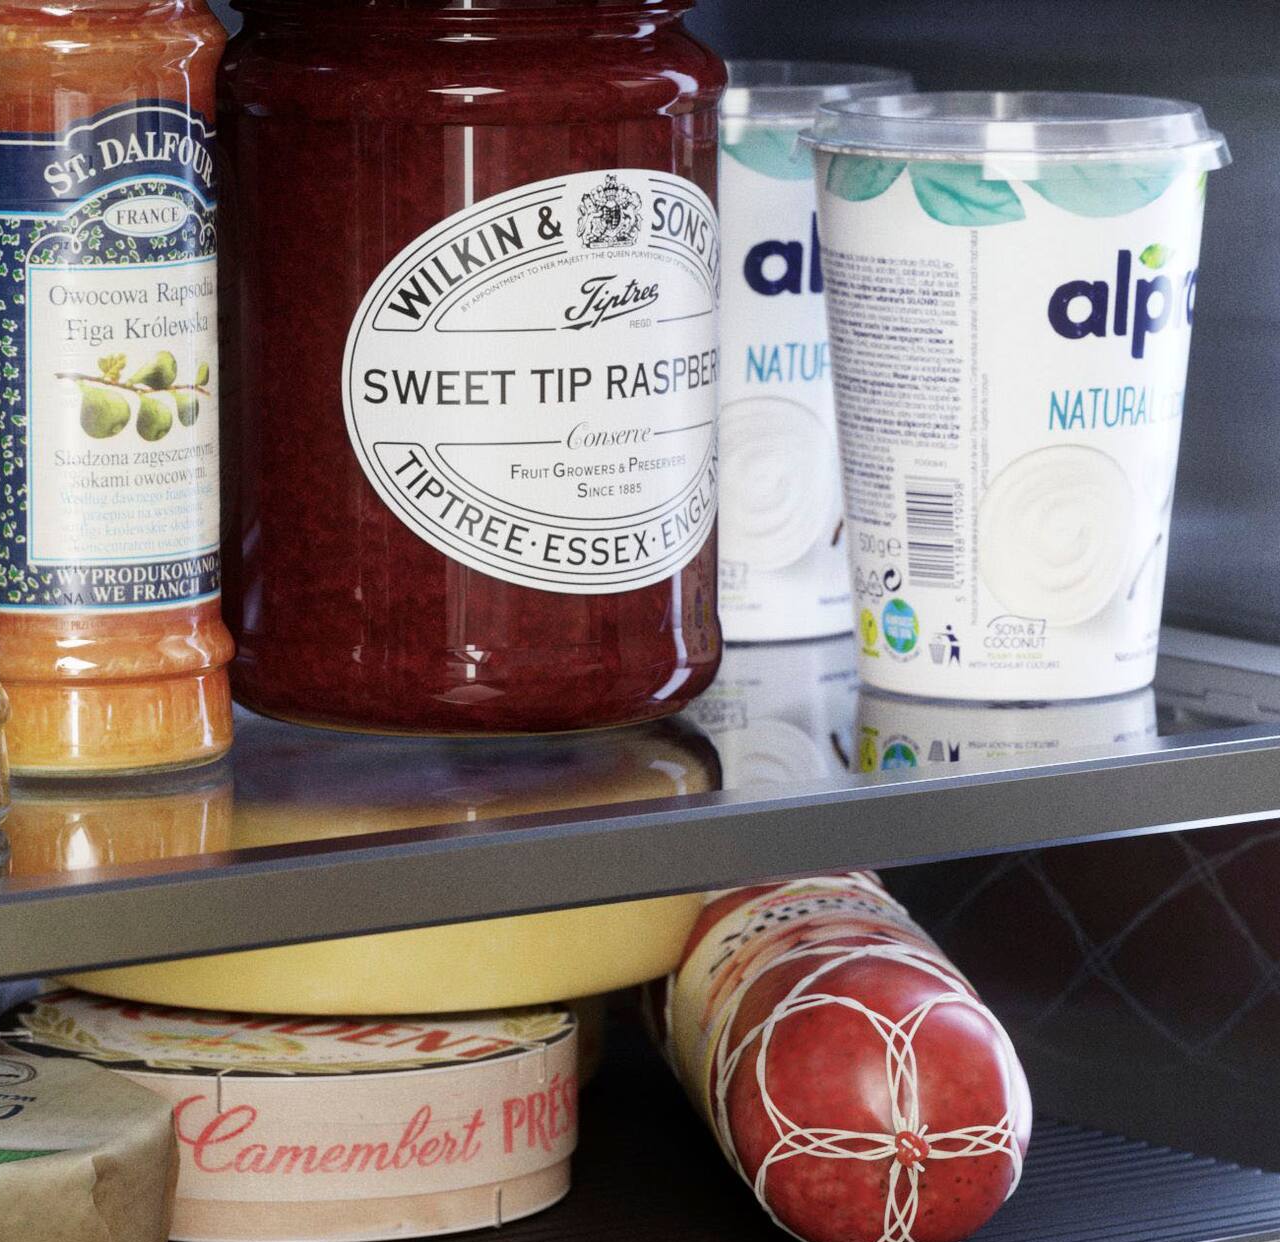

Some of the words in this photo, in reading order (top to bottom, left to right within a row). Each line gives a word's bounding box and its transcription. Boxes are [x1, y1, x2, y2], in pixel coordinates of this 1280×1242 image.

[44, 153, 97, 199] ST.
[97, 131, 214, 189] DALFOUR
[116, 206, 181, 226] FRANCE
[388, 215, 522, 321] WILKIN
[537, 205, 564, 241] &
[650, 197, 709, 256] SONS
[48, 284, 148, 307] Owocowa
[471, 270, 526, 307] APPOINTMENT
[526, 265, 540, 278] TO
[539, 260, 556, 272] HER
[556, 252, 590, 268] MAJESTY
[591, 250, 606, 261] THE
[605, 250, 631, 260] QUEEN
[560, 274, 660, 331] Tiptree
[1047, 249, 1197, 360] alp
[65, 318, 115, 347] Figa
[124, 310, 209, 342] Królewska
[363, 369, 516, 407] SWEET
[530, 367, 593, 404] TIP
[565, 420, 652, 451] Conserve
[617, 480, 643, 496] 1885
[55, 555, 216, 586] WYPRODUKOWANO
[93, 586, 127, 603] WE
[132, 577, 201, 602] FRANCJI
[983, 637, 1048, 650] COCONUT
[995, 624, 1026, 636] SOYA
[172, 1094, 485, 1174] Camembert
